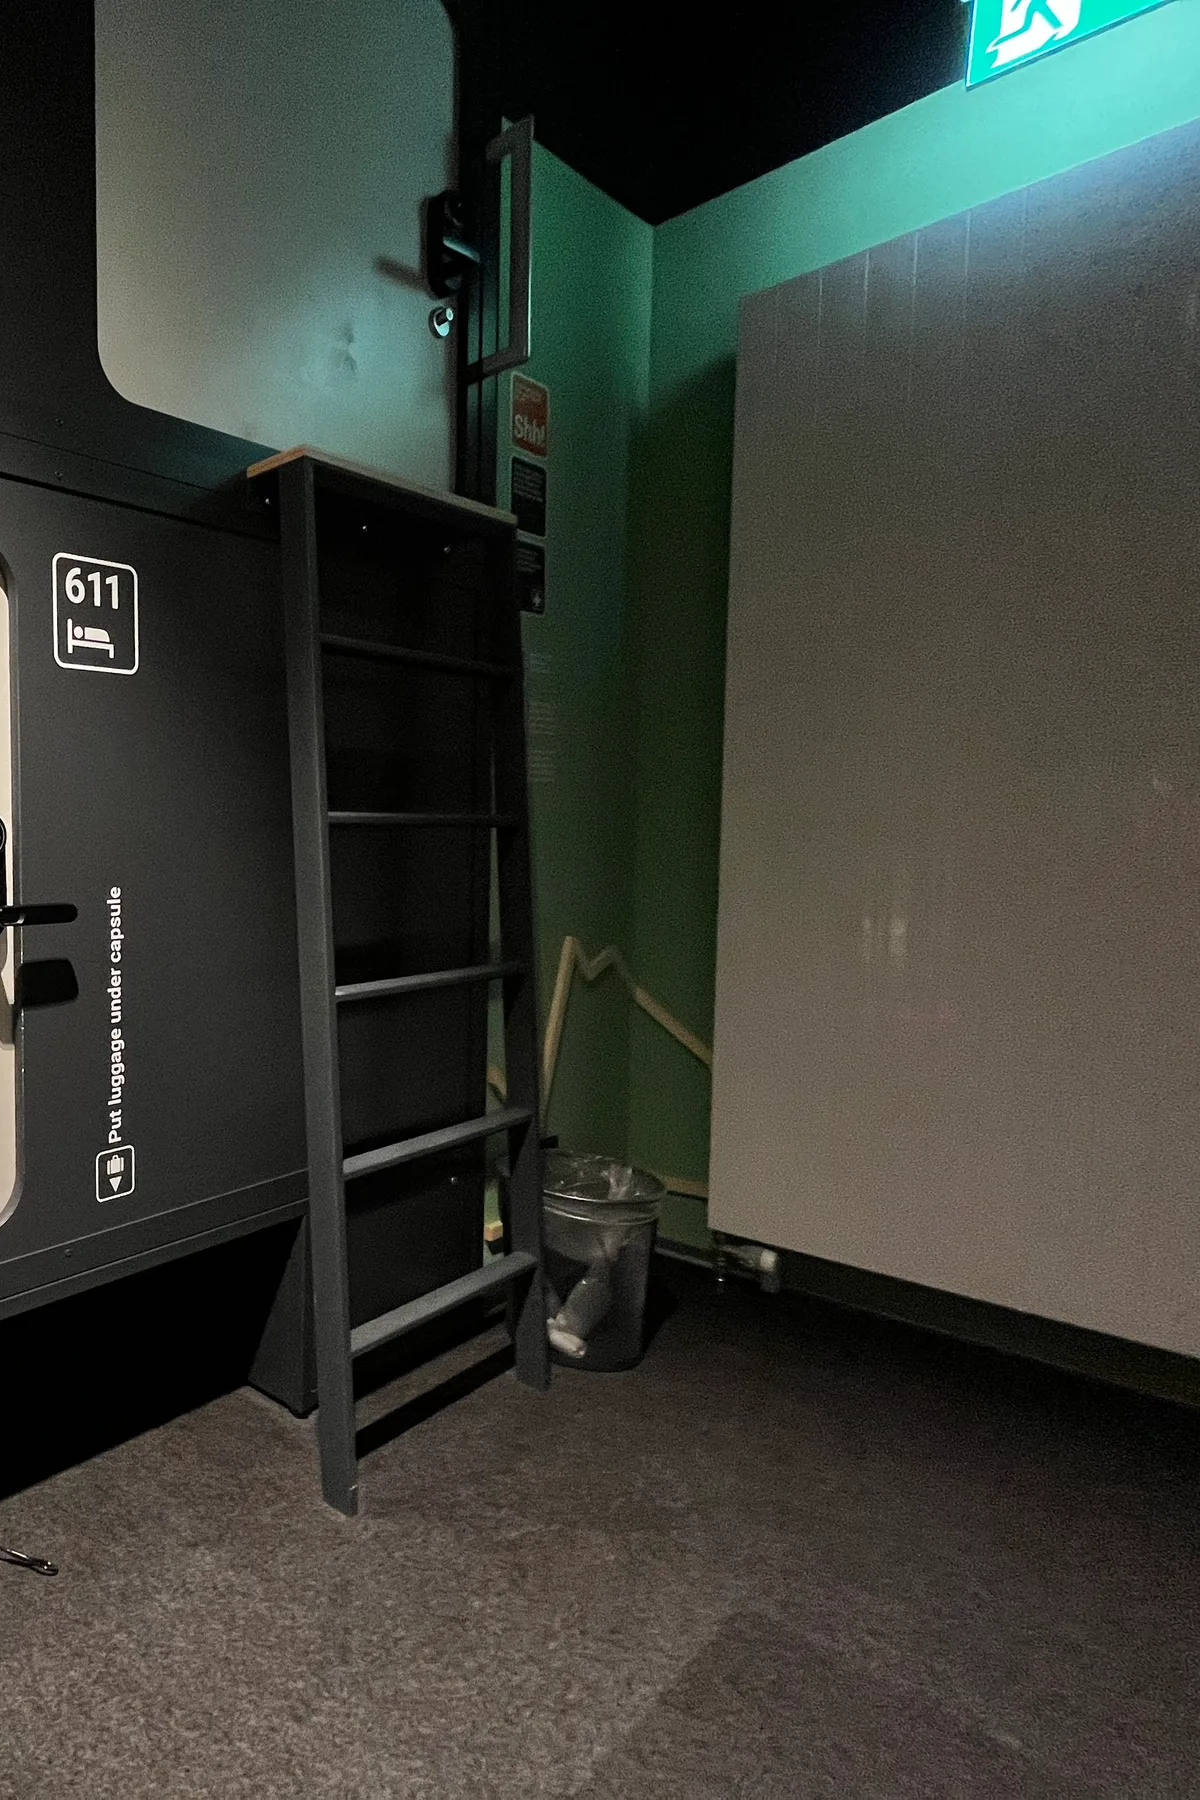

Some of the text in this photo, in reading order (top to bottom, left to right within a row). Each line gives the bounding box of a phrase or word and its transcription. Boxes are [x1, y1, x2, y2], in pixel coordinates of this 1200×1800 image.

[65, 567, 119, 610] 611
[106, 886, 125, 1144] Put luggage under capsule
